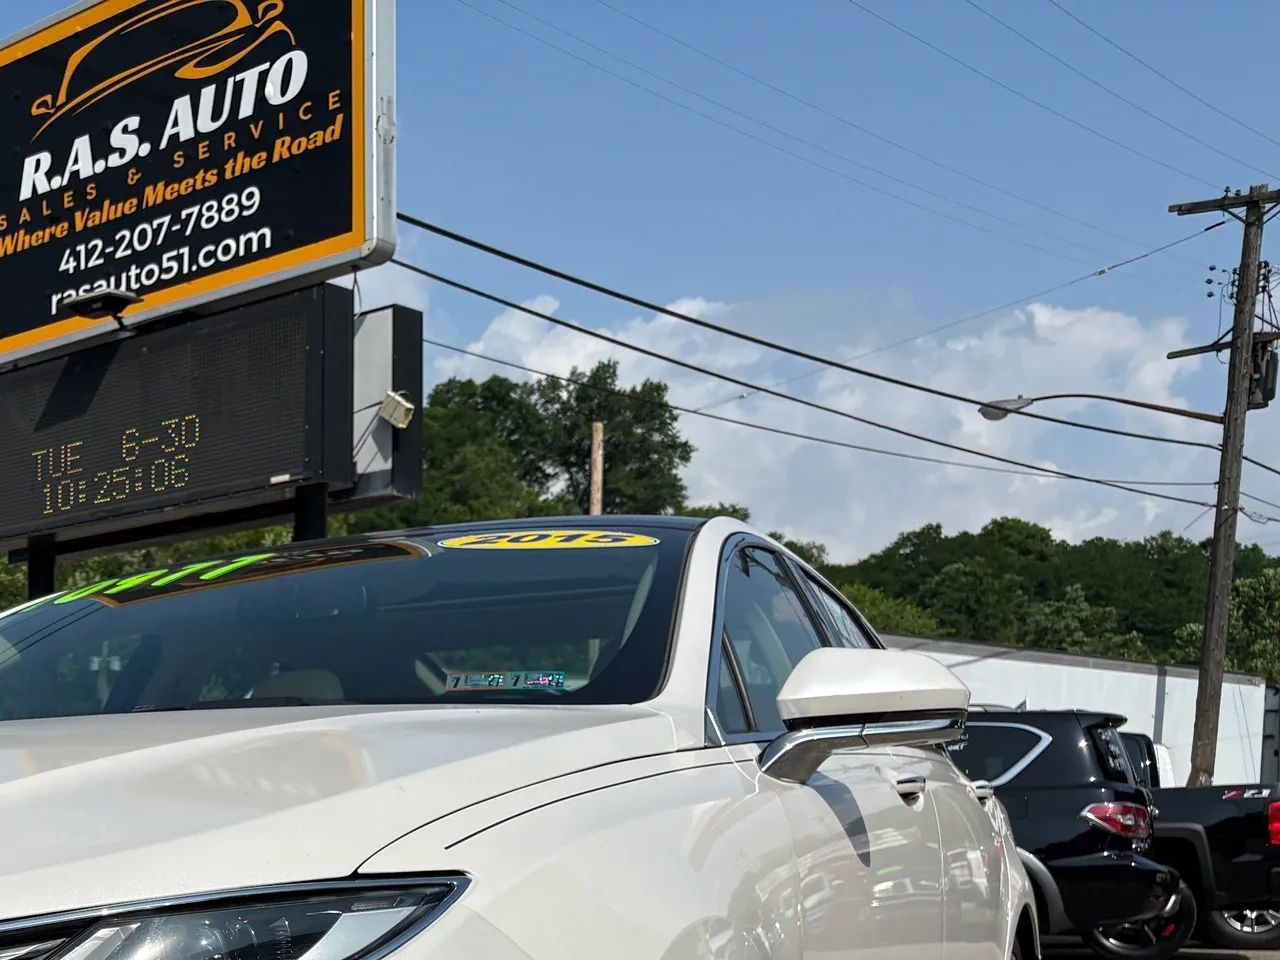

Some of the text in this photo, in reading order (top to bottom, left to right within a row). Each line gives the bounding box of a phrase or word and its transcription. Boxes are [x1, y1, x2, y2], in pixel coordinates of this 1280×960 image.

[20, 49, 308, 201] R.A.S. AUTO
[127, 169, 142, 185] &
[173, 90, 342, 168] SERVICE
[74, 197, 137, 232] Value
[142, 168, 219, 210] Meets
[224, 149, 267, 180] the
[272, 113, 344, 164] Road
[58, 186, 261, 274] 412-207-7889
[32, 414, 200, 480] TUE 6-30
[43, 454, 189, 514] 10:25:06
[459, 533, 634, 545] 2015
